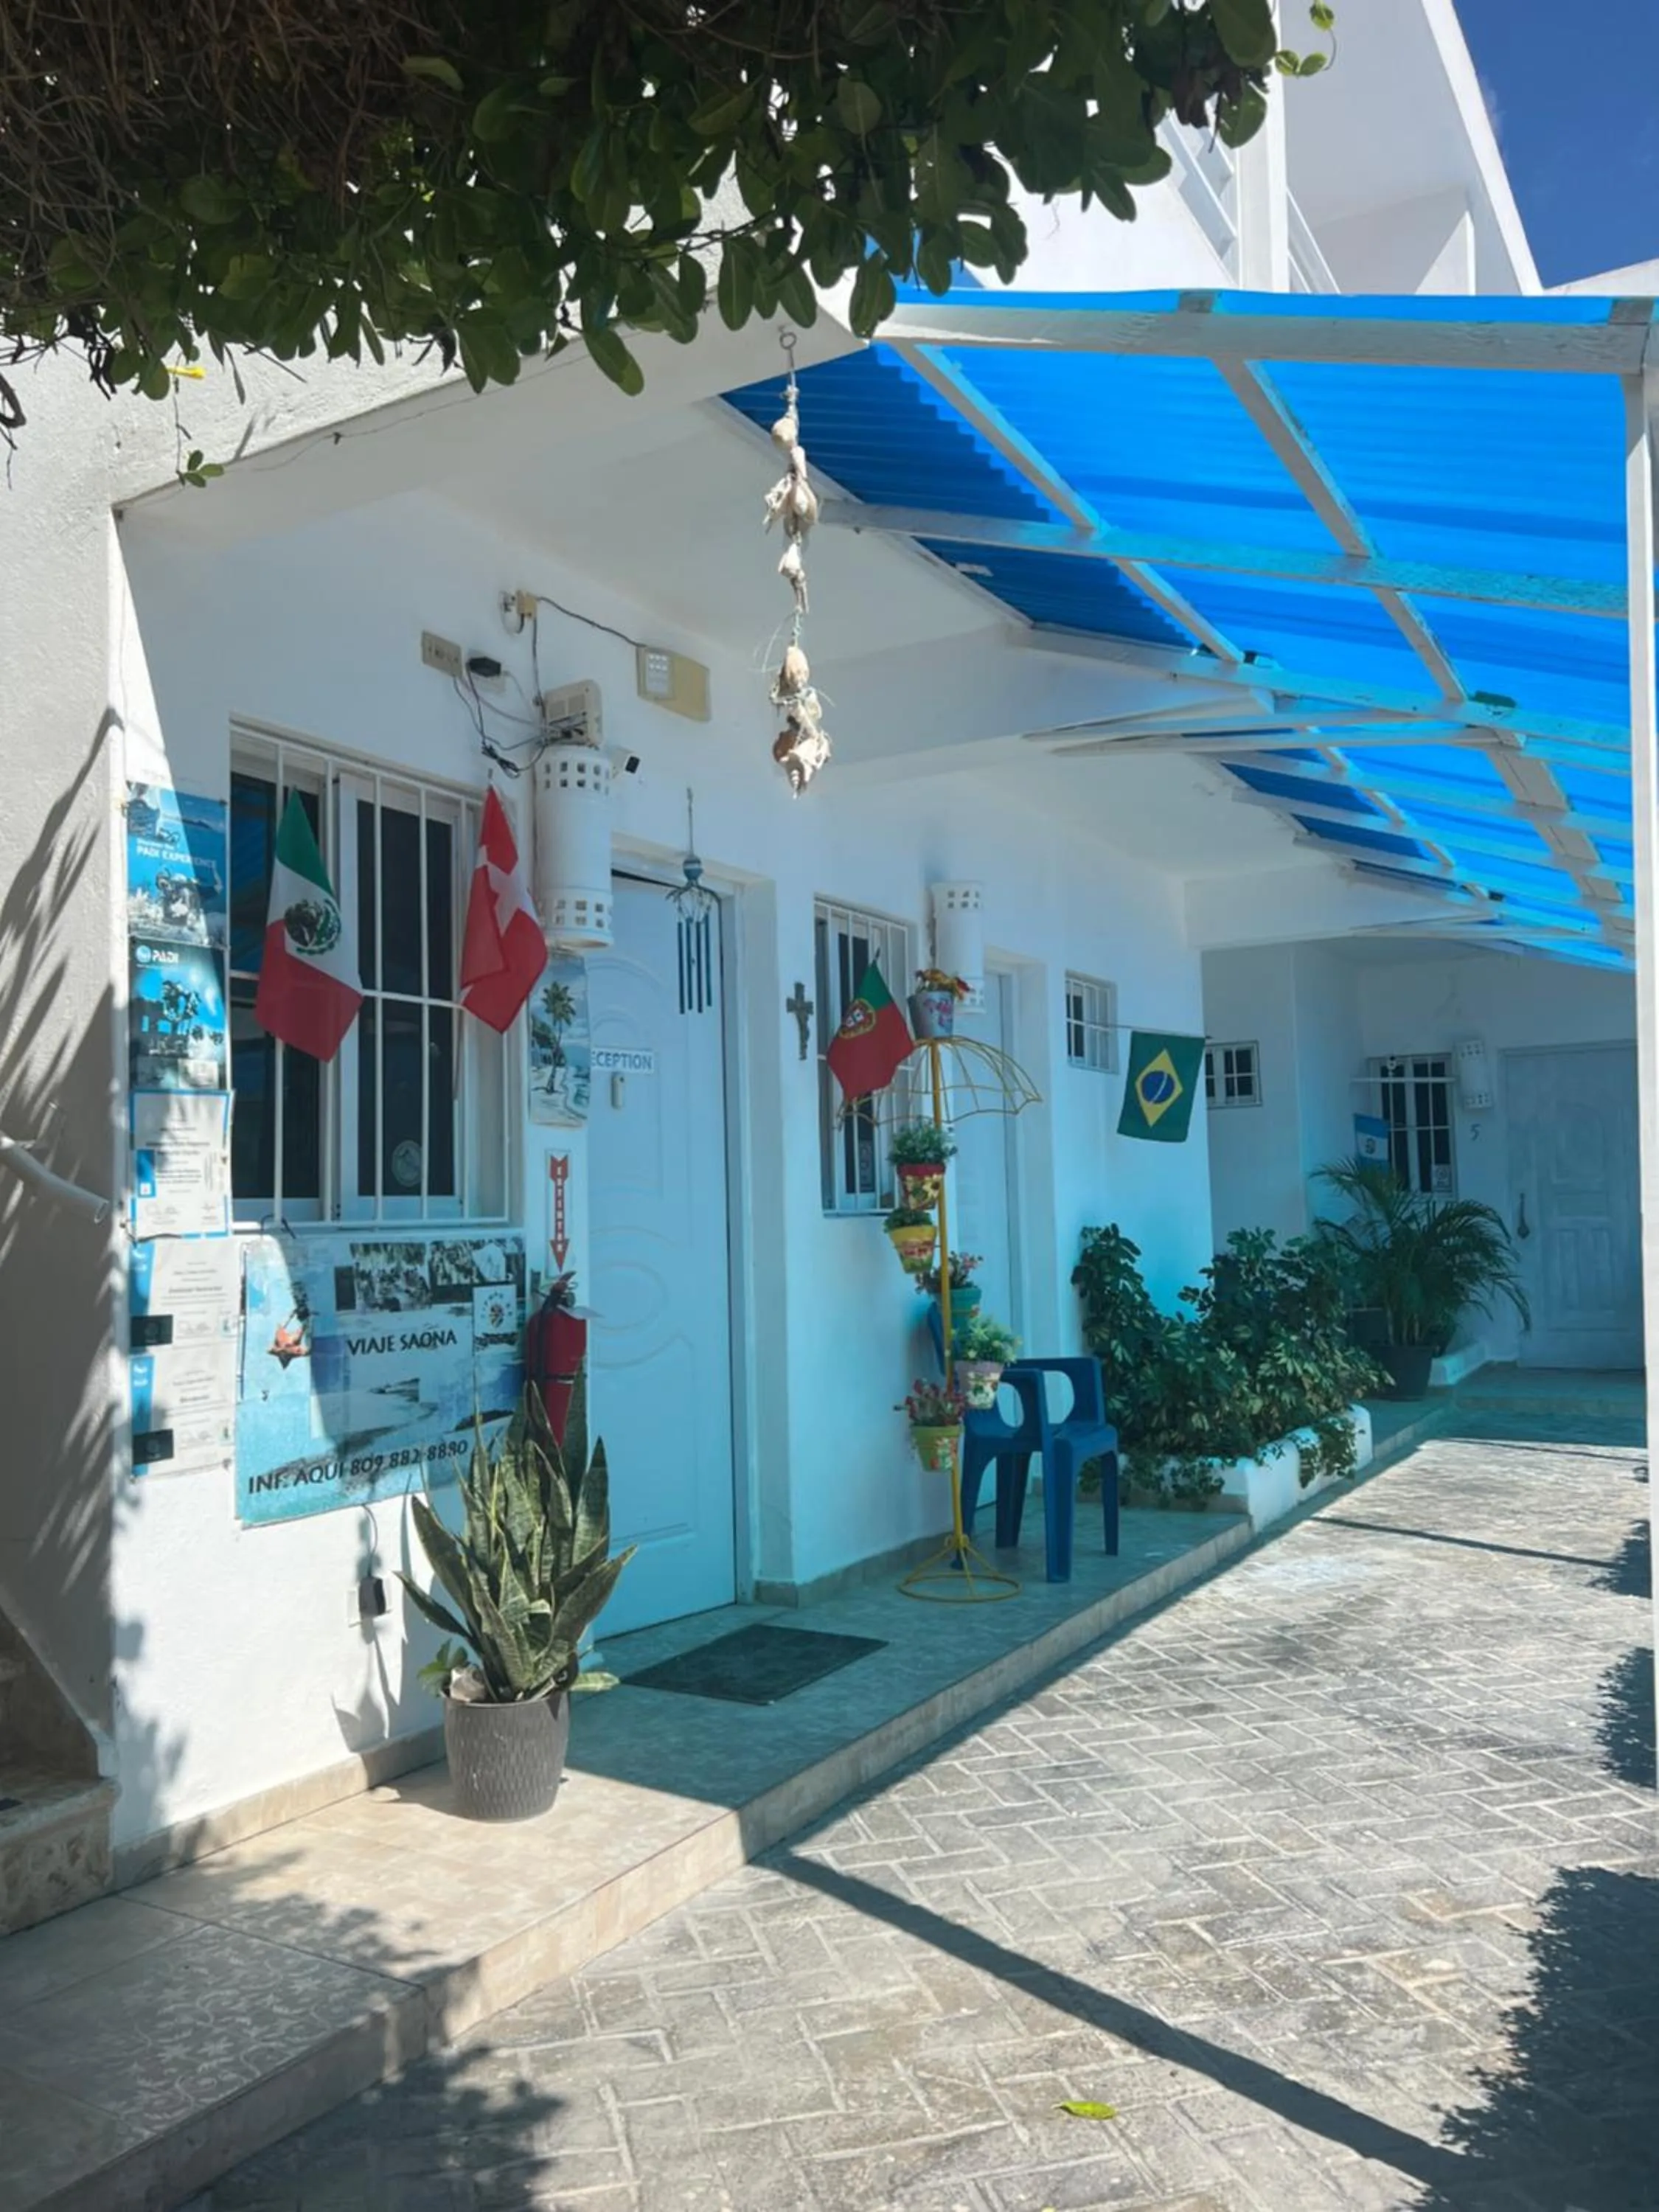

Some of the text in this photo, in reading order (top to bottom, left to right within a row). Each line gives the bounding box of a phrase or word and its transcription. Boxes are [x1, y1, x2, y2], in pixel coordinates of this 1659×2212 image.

[153, 949, 179, 964] PADI
[591, 1051, 653, 1070] ECEPTION
[347, 1328, 458, 1355] VIAJE SAONA
[293, 1462, 344, 1486] AQUI
[350, 1455, 383, 1475] 809
